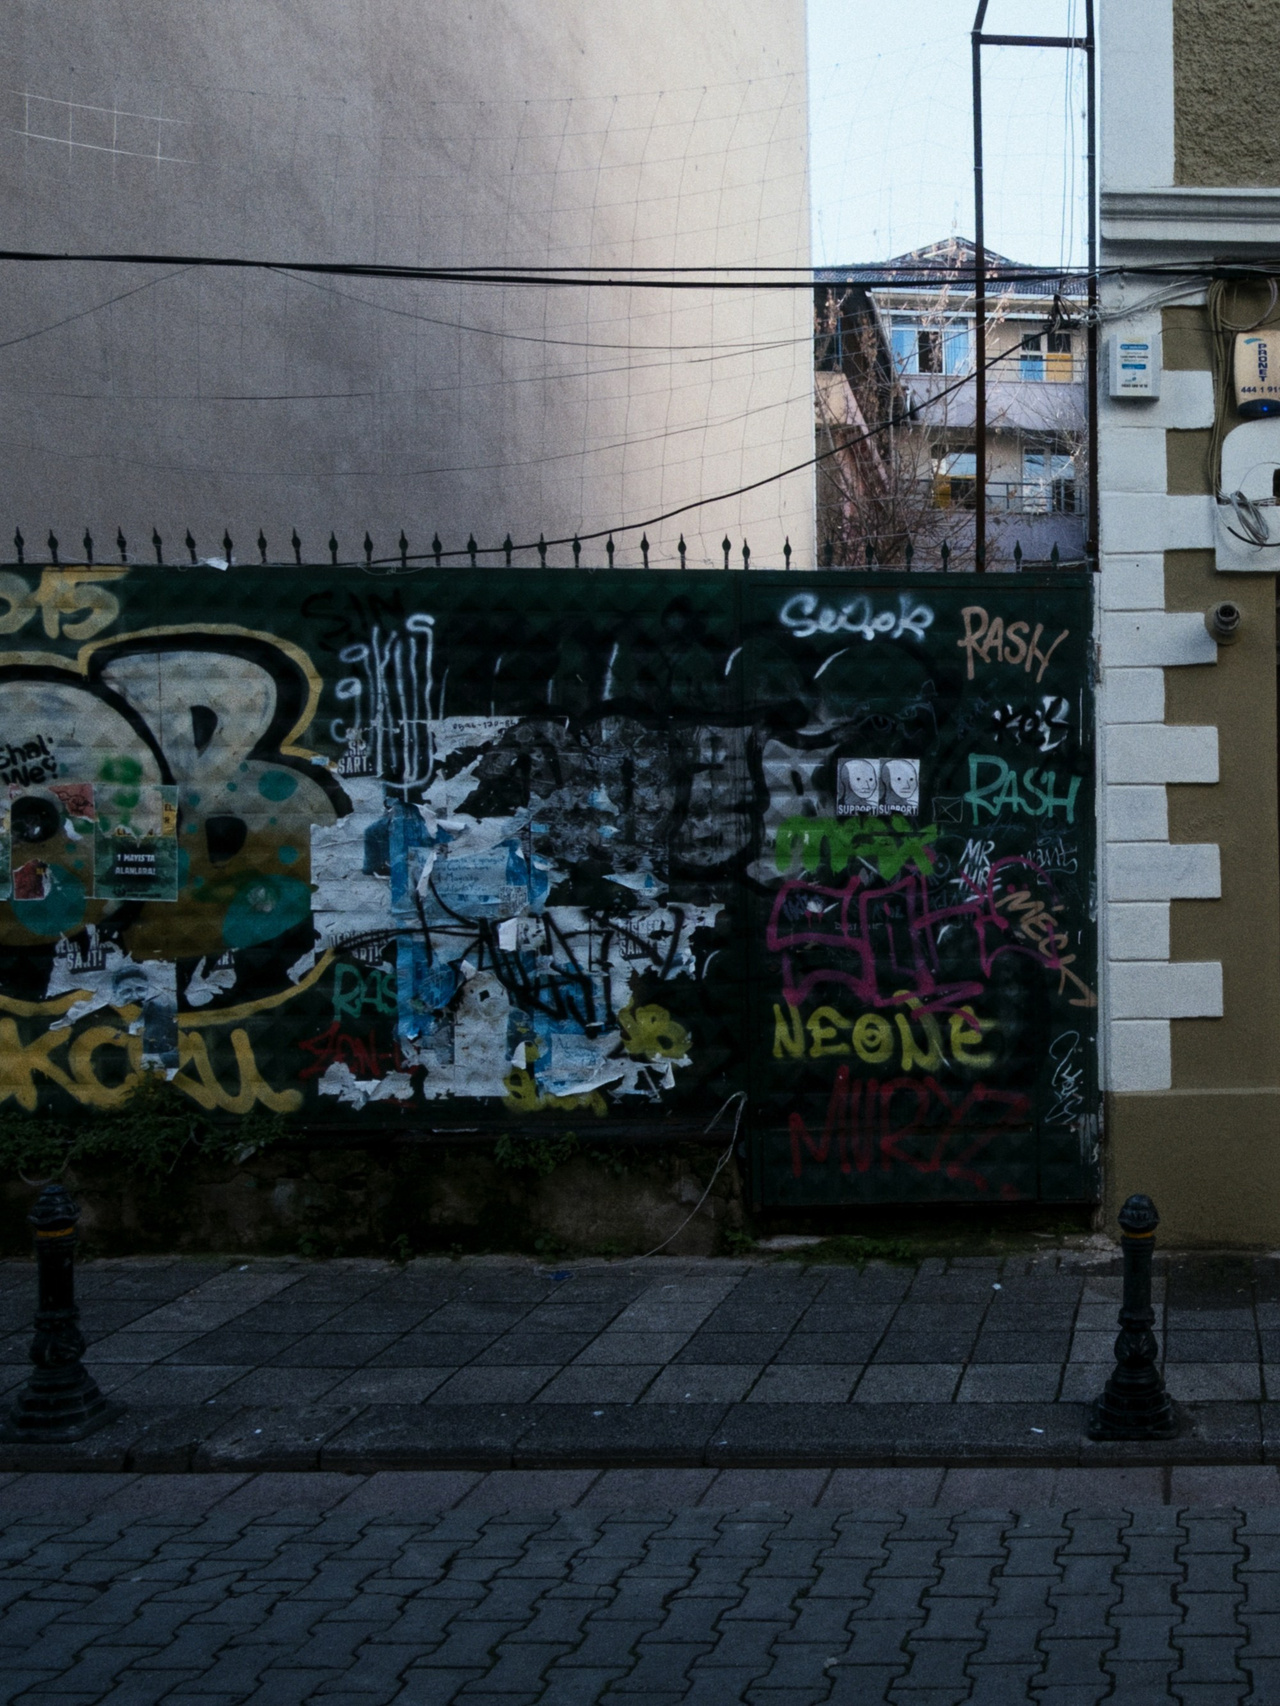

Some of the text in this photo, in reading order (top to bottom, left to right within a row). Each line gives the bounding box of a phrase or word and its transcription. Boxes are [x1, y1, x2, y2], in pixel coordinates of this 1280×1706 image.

[1257, 343, 1268, 382] PRONET
[957, 605, 1070, 684] RASH
[963, 752, 1084, 826] RASH
[838, 803, 878, 816] SUPPORT
[879, 803, 918, 816] SUPPORT
